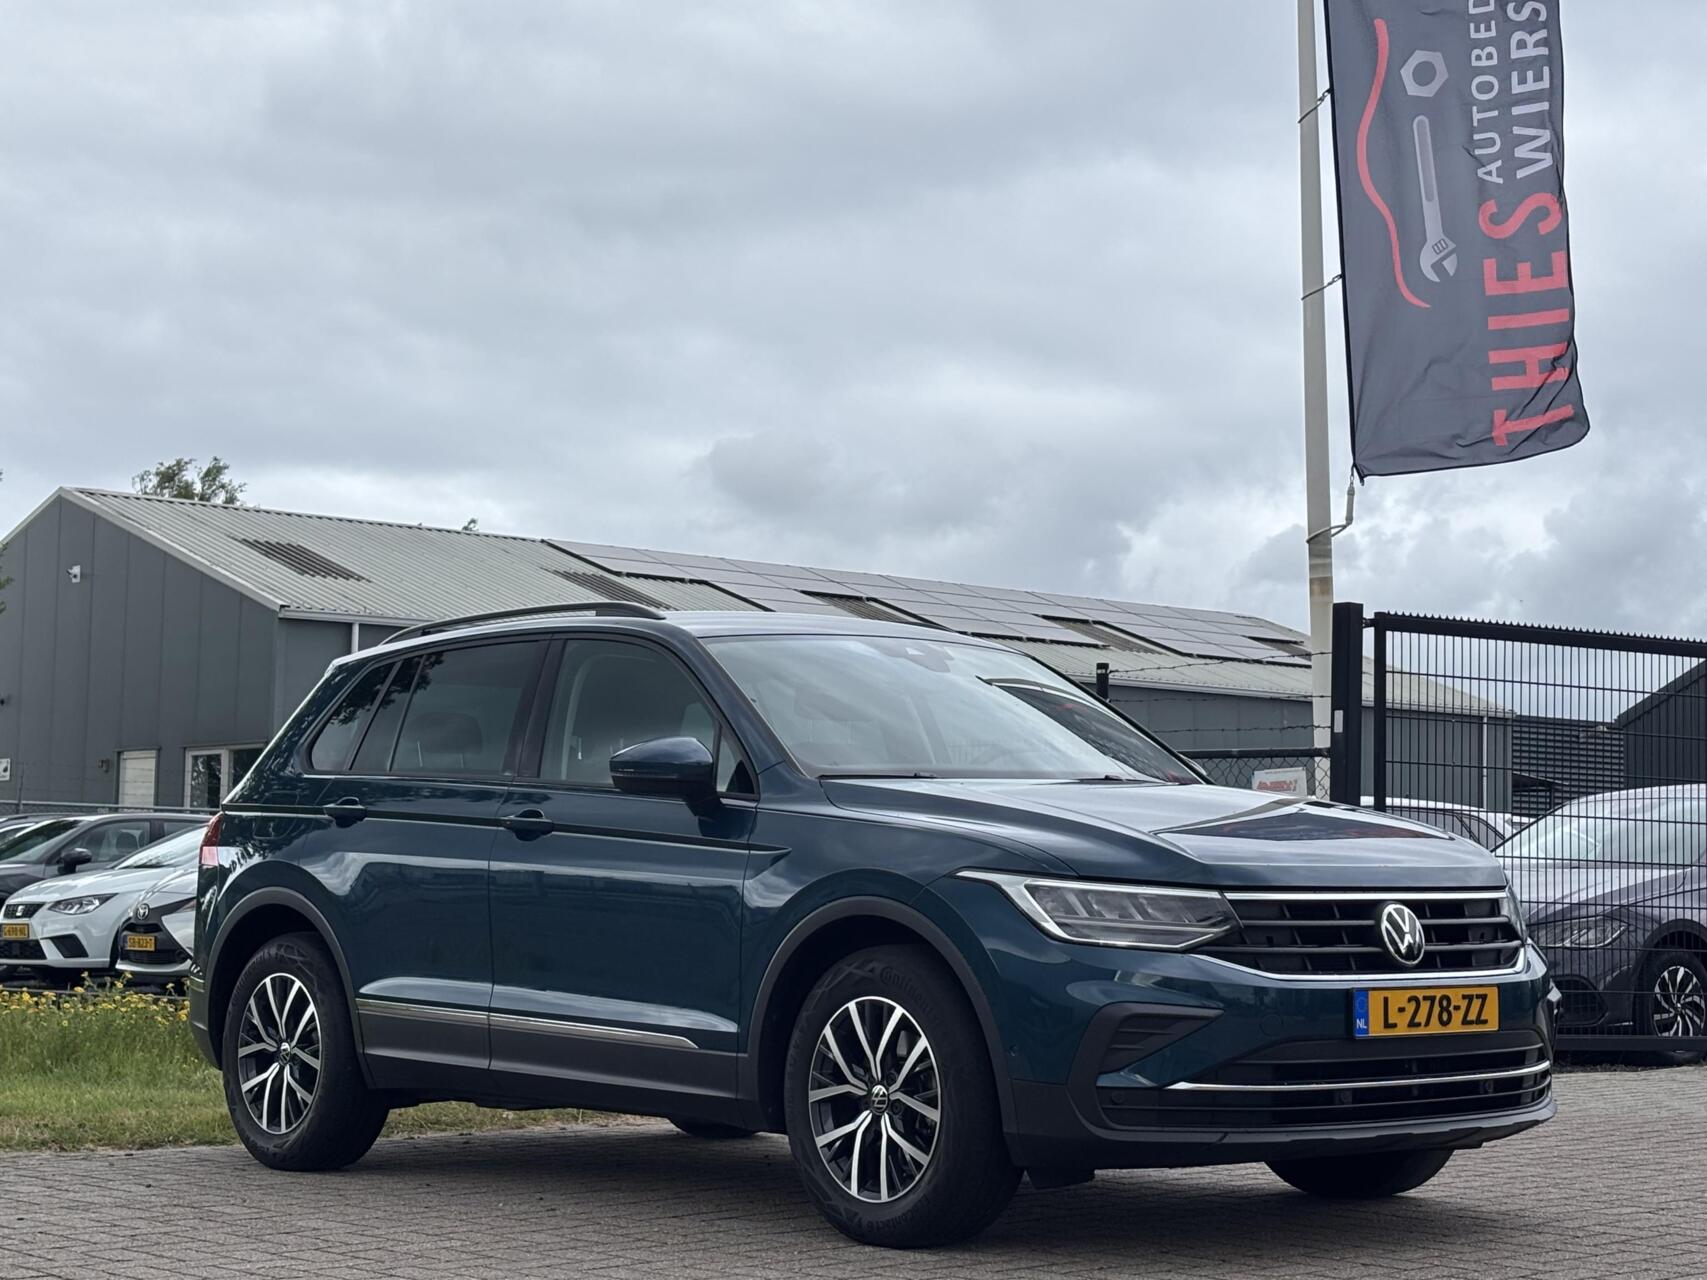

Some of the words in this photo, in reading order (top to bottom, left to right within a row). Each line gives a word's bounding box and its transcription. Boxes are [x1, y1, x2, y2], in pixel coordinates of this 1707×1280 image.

[1468, 0, 1503, 184] AUTOBED
[1506, 1, 1554, 180] WIERS
[1478, 192, 1574, 446] THIES
[880, 966, 938, 1023] Continent
[1355, 1018, 1368, 1030] NL
[1382, 993, 1489, 1029] L-278-ZZ
